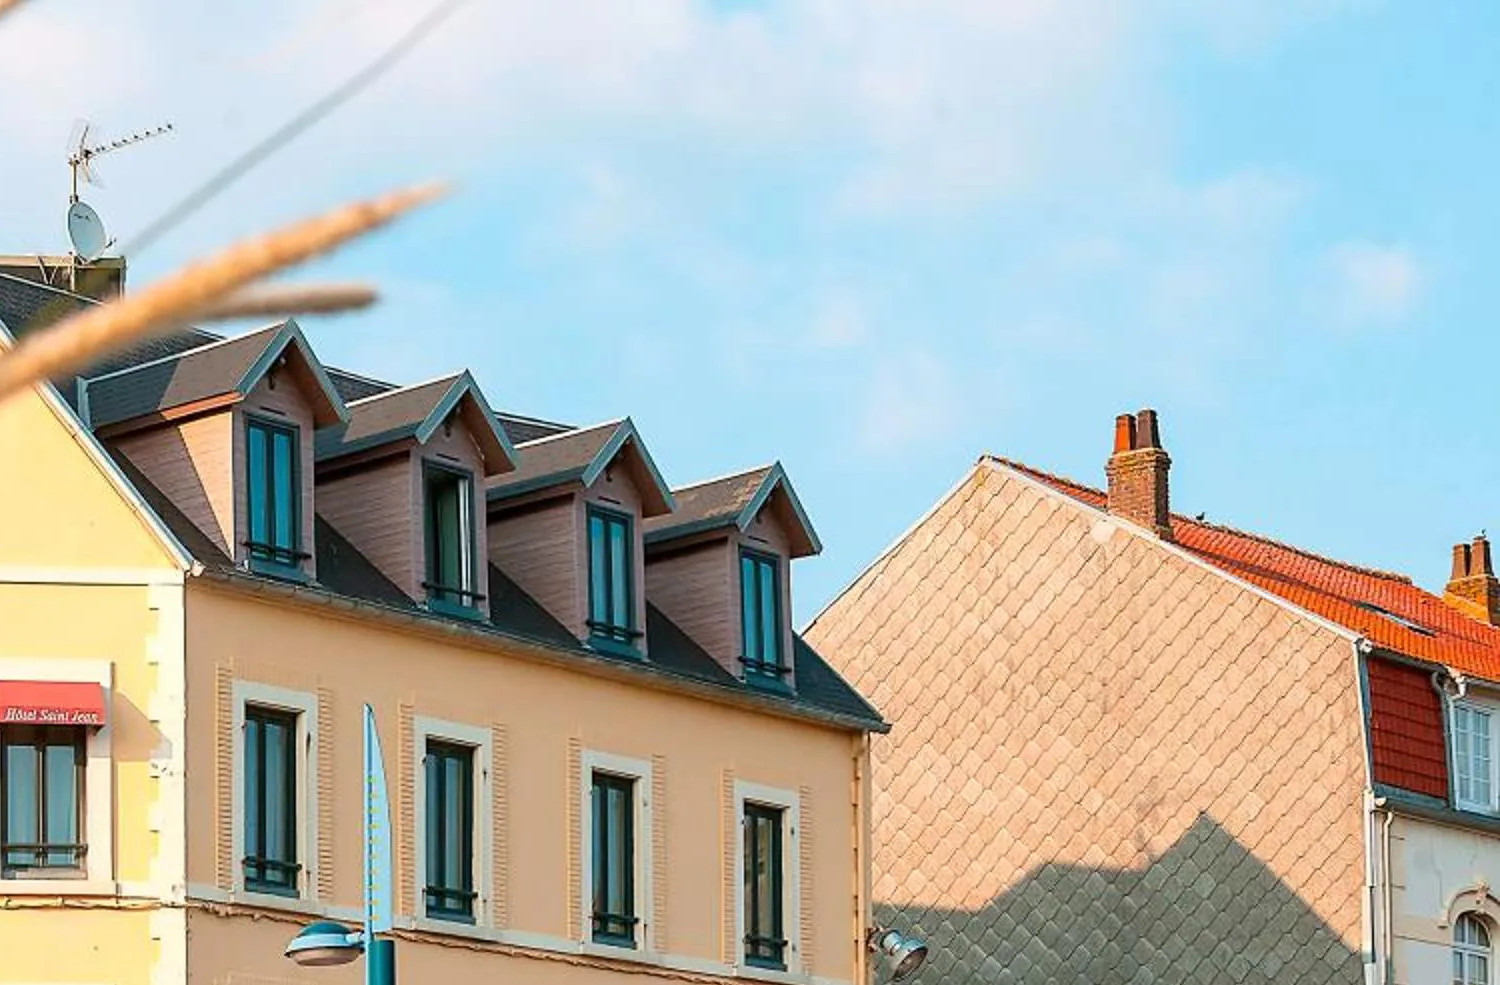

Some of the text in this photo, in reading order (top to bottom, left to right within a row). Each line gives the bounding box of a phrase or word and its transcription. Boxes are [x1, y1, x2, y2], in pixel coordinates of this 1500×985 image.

[5, 707, 98, 723] Hôtel Saint Jean
